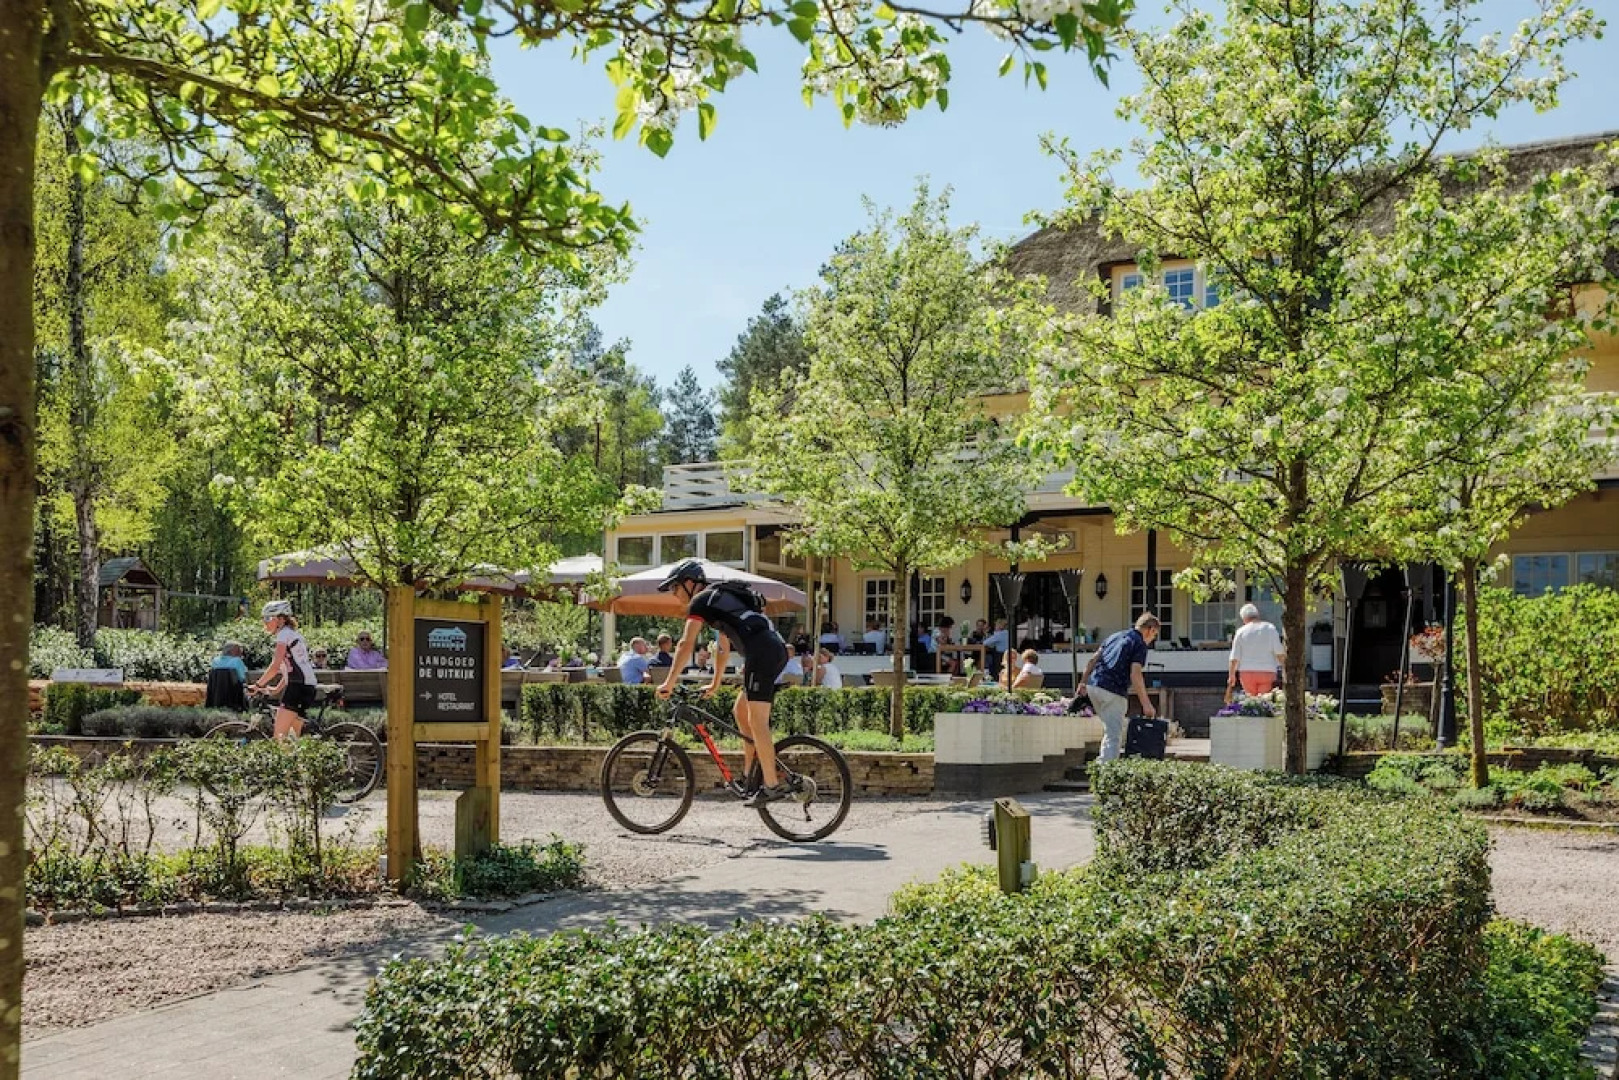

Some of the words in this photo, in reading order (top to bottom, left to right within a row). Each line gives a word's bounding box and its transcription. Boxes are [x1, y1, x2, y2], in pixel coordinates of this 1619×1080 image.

[419, 656, 475, 667] LANDGOED
[419, 668, 432, 678] DE
[438, 692, 457, 701] HOTEL
[438, 702, 475, 711] RESTAURANT
